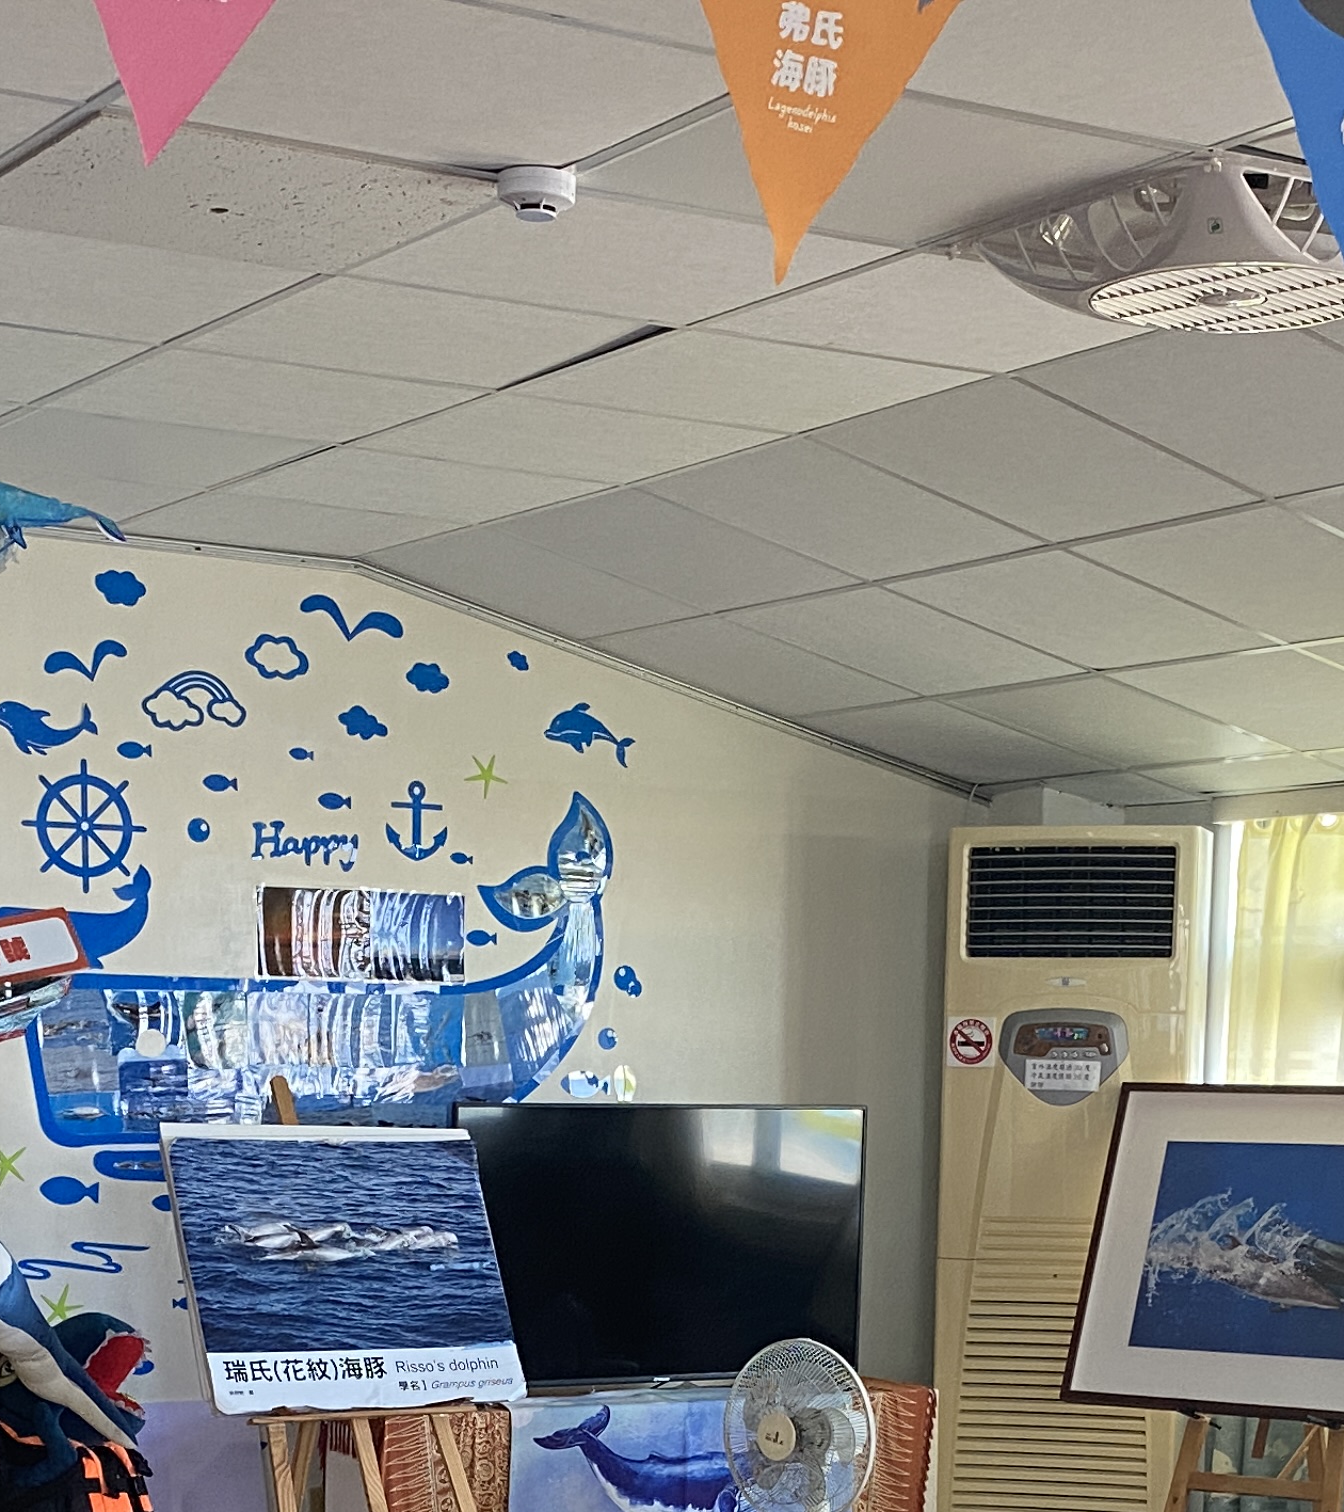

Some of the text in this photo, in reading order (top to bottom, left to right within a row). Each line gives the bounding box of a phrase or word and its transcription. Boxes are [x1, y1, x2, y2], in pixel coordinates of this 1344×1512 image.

[779, 1, 843, 49] 弗氏
[771, 49, 838, 97] 海豚
[251, 820, 358, 873] Happy
[222, 1356, 388, 1383] 瑞氏(花紋)海豚
[396, 1357, 499, 1374] Risso's dolphin
[431, 1379, 476, 1390] Grampus
[478, 1377, 514, 1389] griseus
